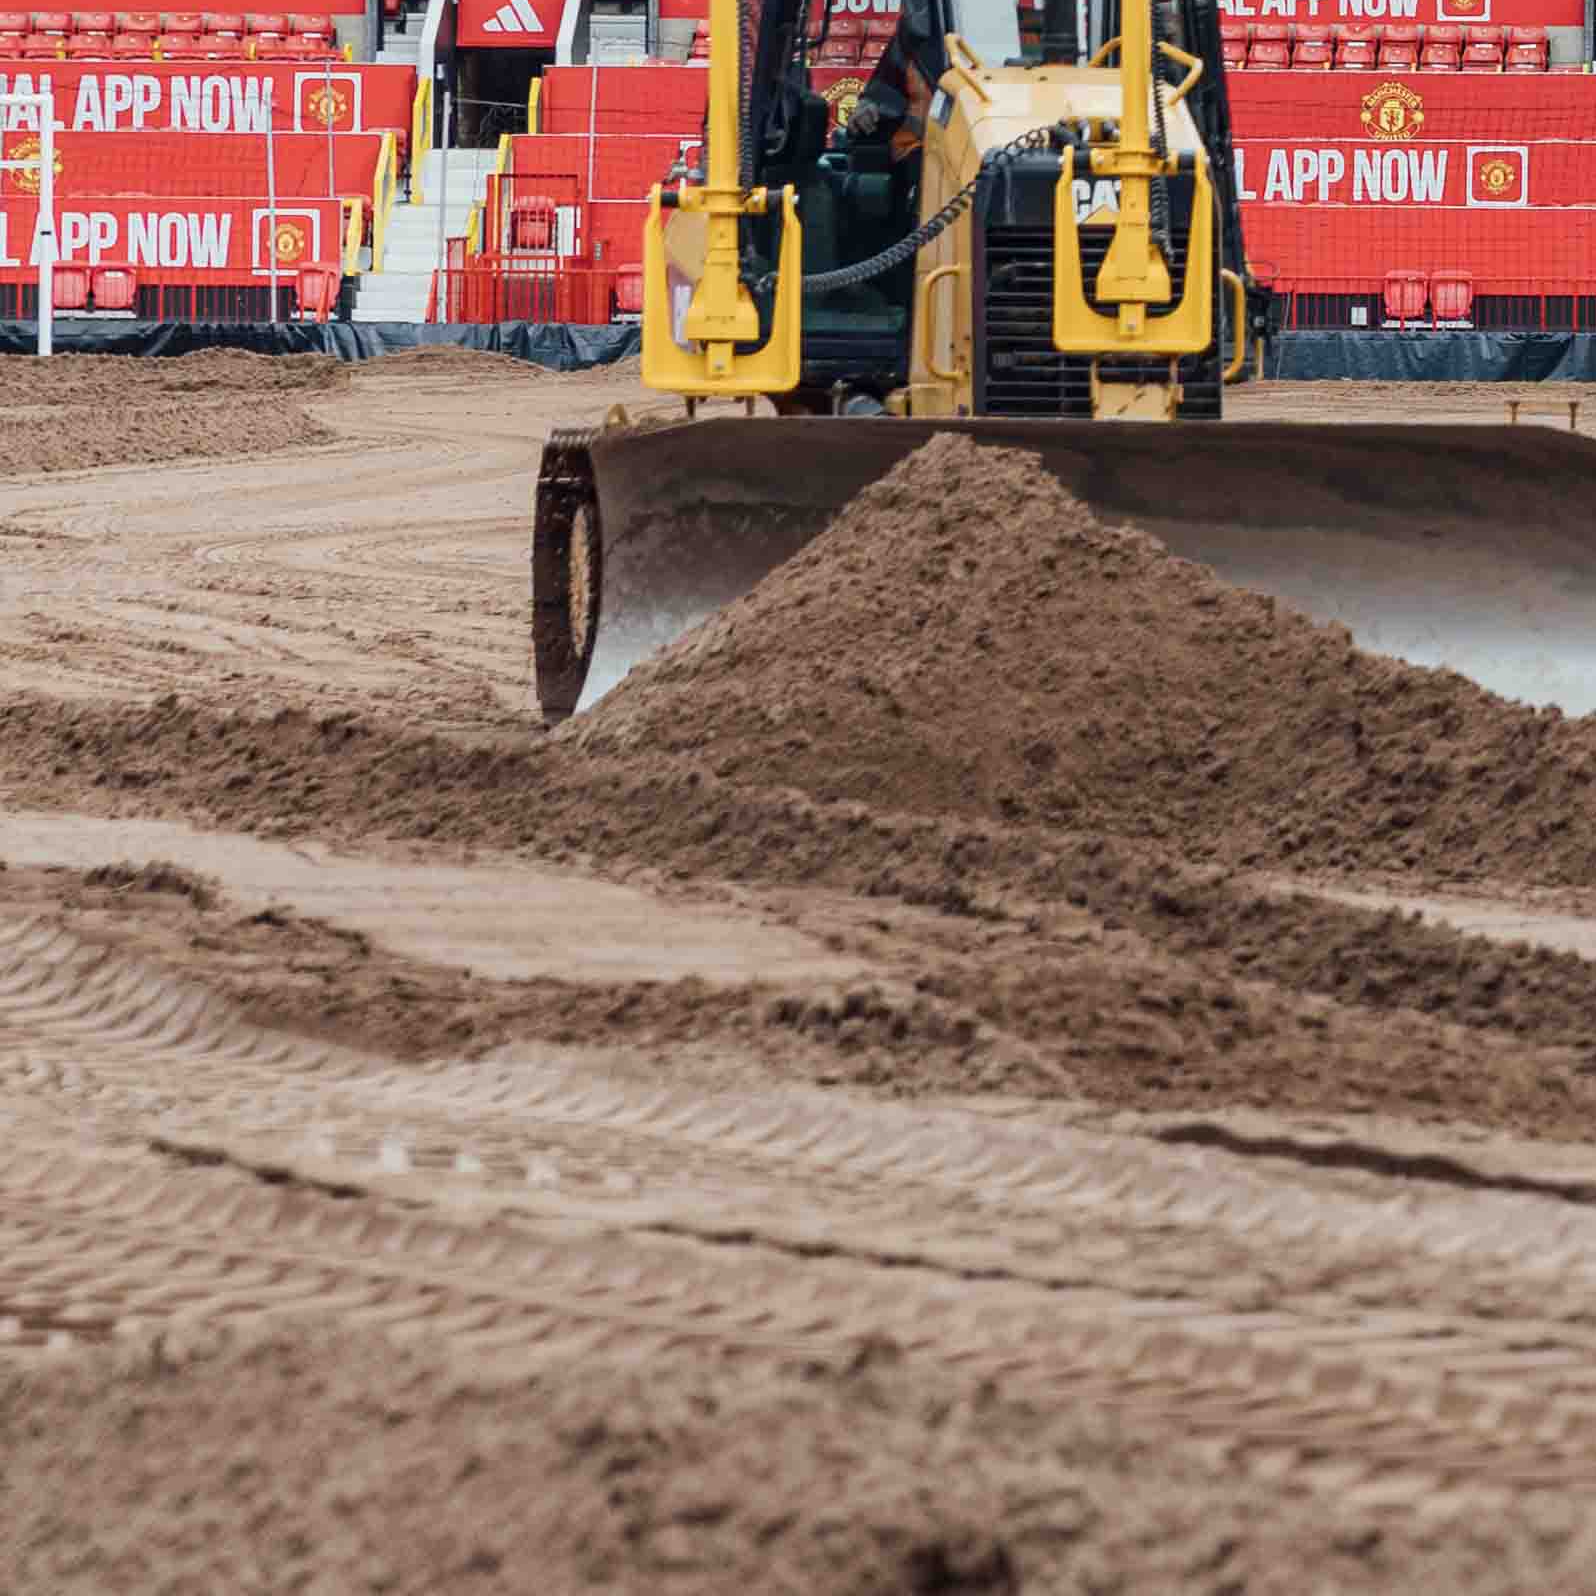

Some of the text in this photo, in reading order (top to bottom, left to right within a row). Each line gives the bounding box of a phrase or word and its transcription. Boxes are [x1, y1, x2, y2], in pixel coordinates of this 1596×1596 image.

[72, 74, 161, 132] APP
[170, 75, 273, 132] NOW
[1072, 179, 1120, 224] CA
[1264, 149, 1345, 201] APP
[1353, 150, 1448, 202] NOW
[127, 212, 232, 269] NOW
